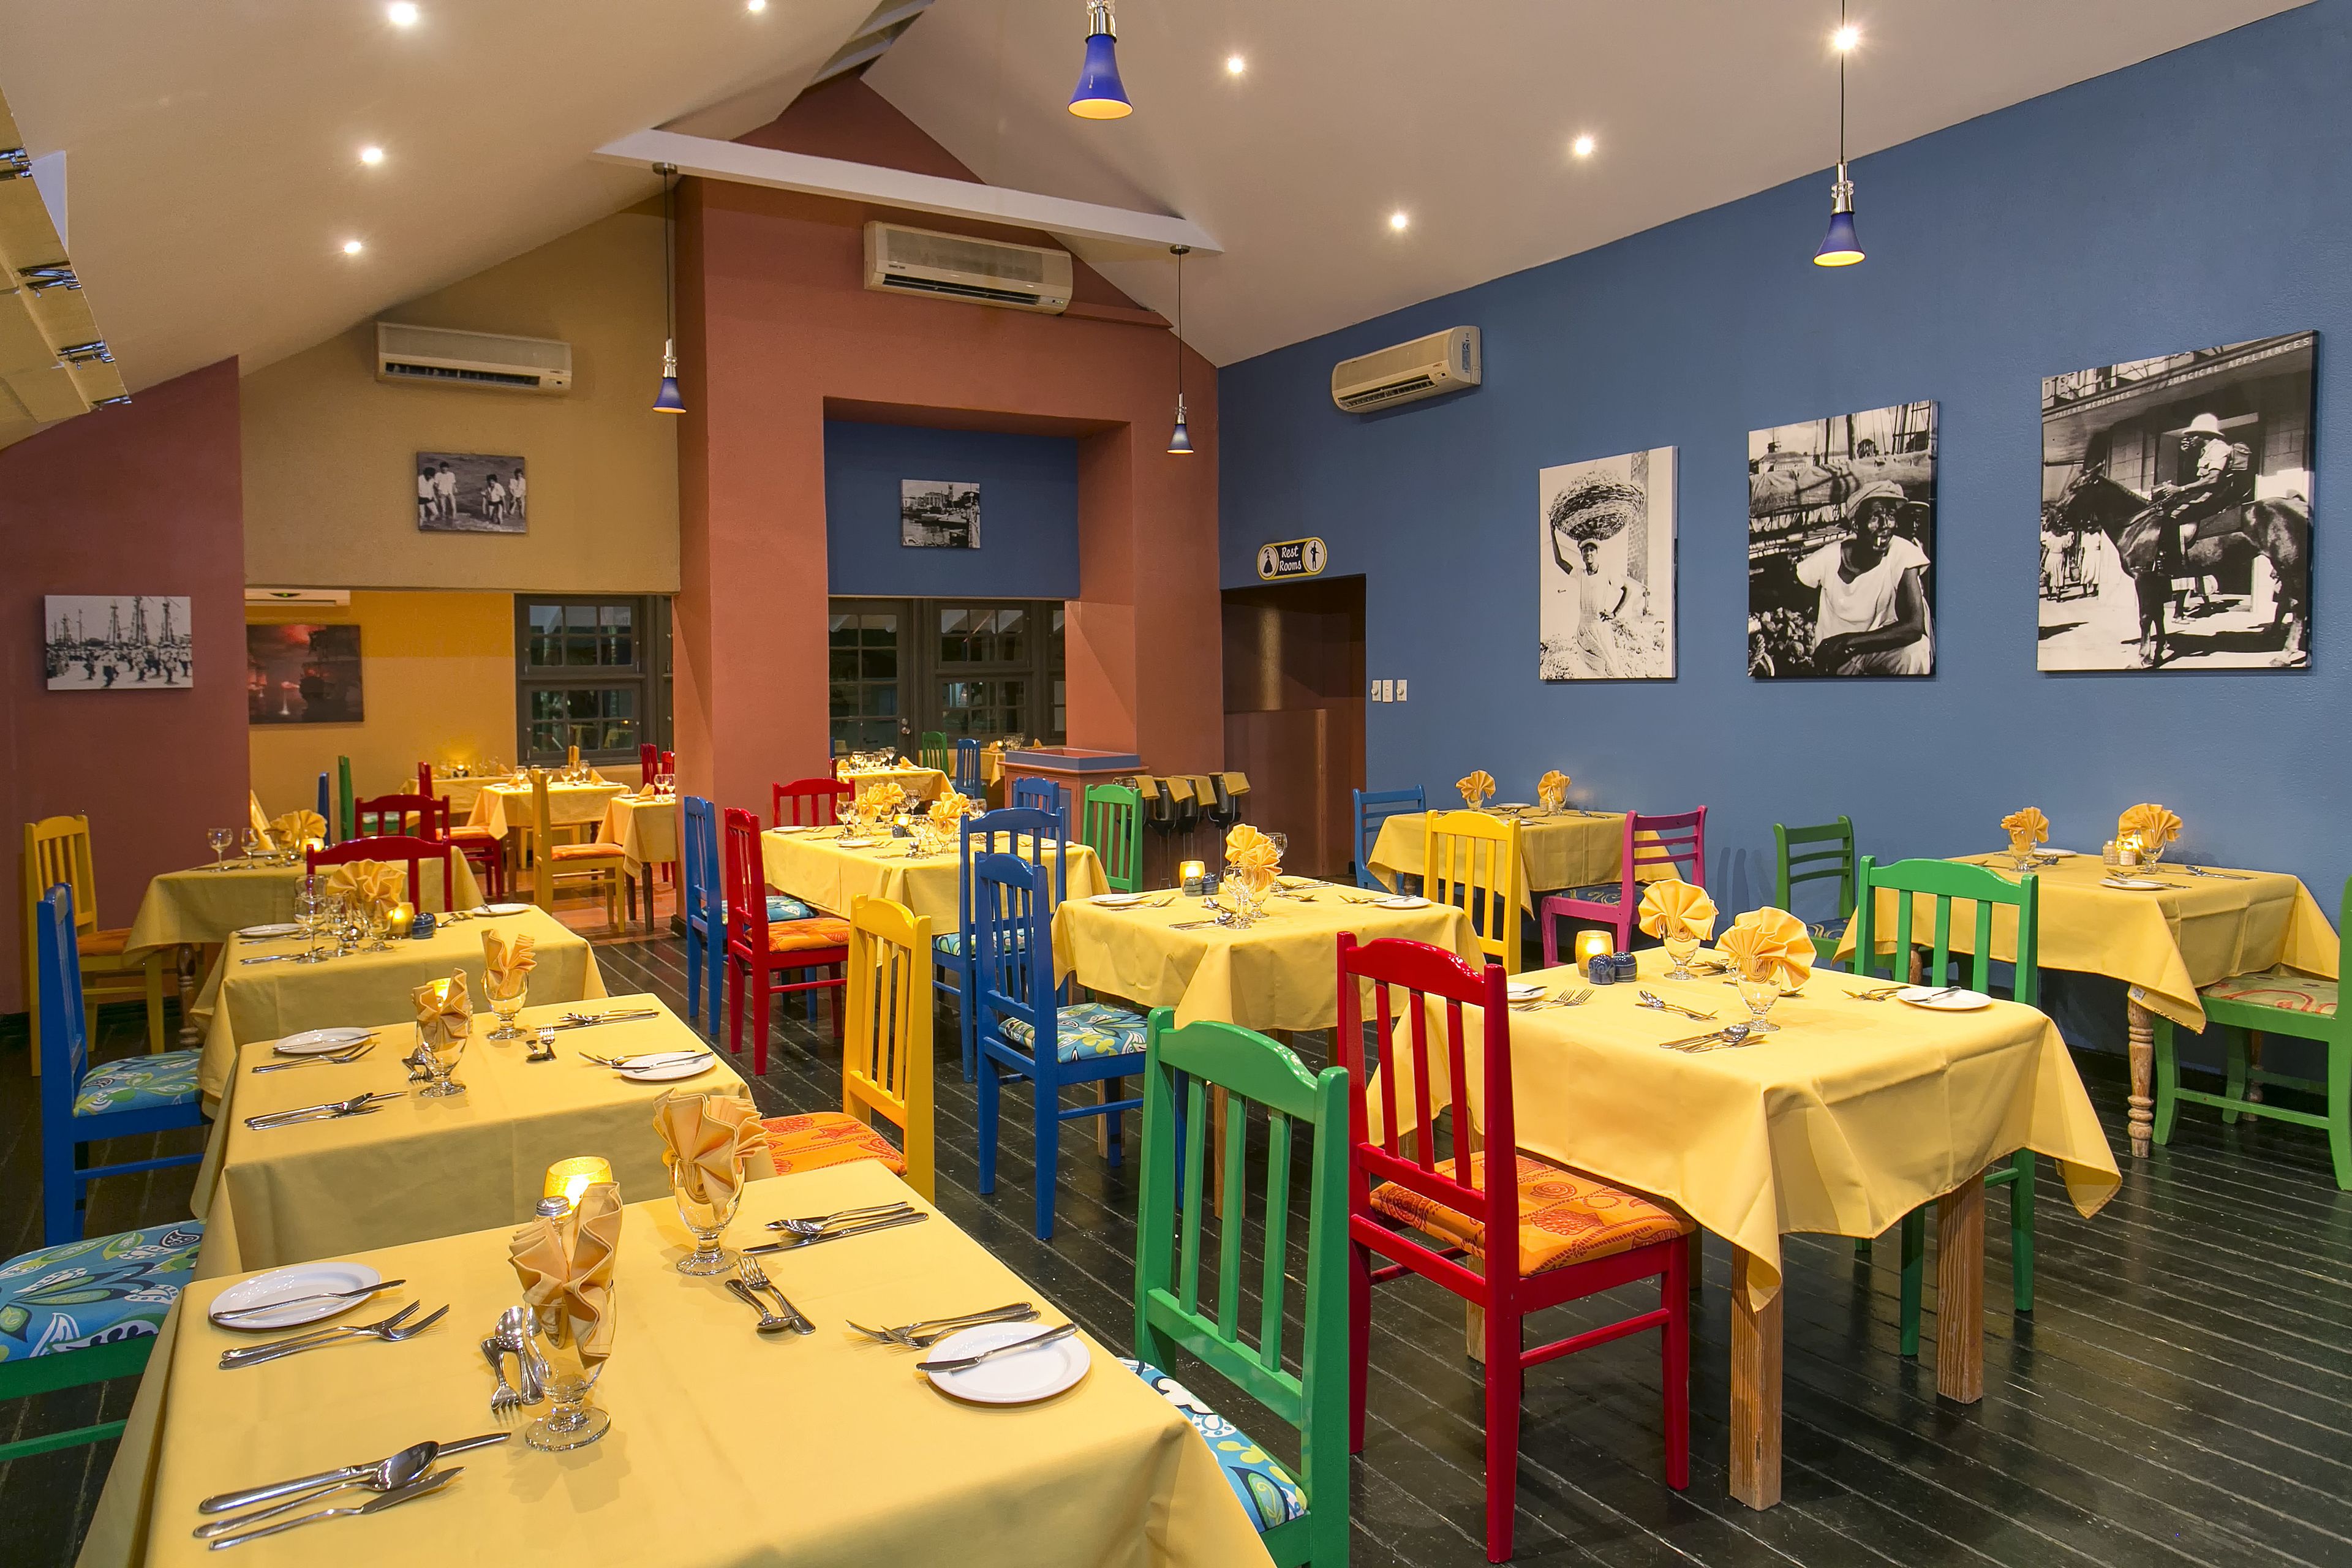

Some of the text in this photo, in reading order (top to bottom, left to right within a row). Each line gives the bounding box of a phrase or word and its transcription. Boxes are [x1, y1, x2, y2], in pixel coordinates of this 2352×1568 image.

[2056, 406, 2081, 419] PATENT
[2085, 392, 2131, 410] MEDICINES
[2228, 337, 2310, 368] APPLIANCES
[1282, 546, 1298, 558] Rest
[1280, 560, 1302, 571] Rooms
